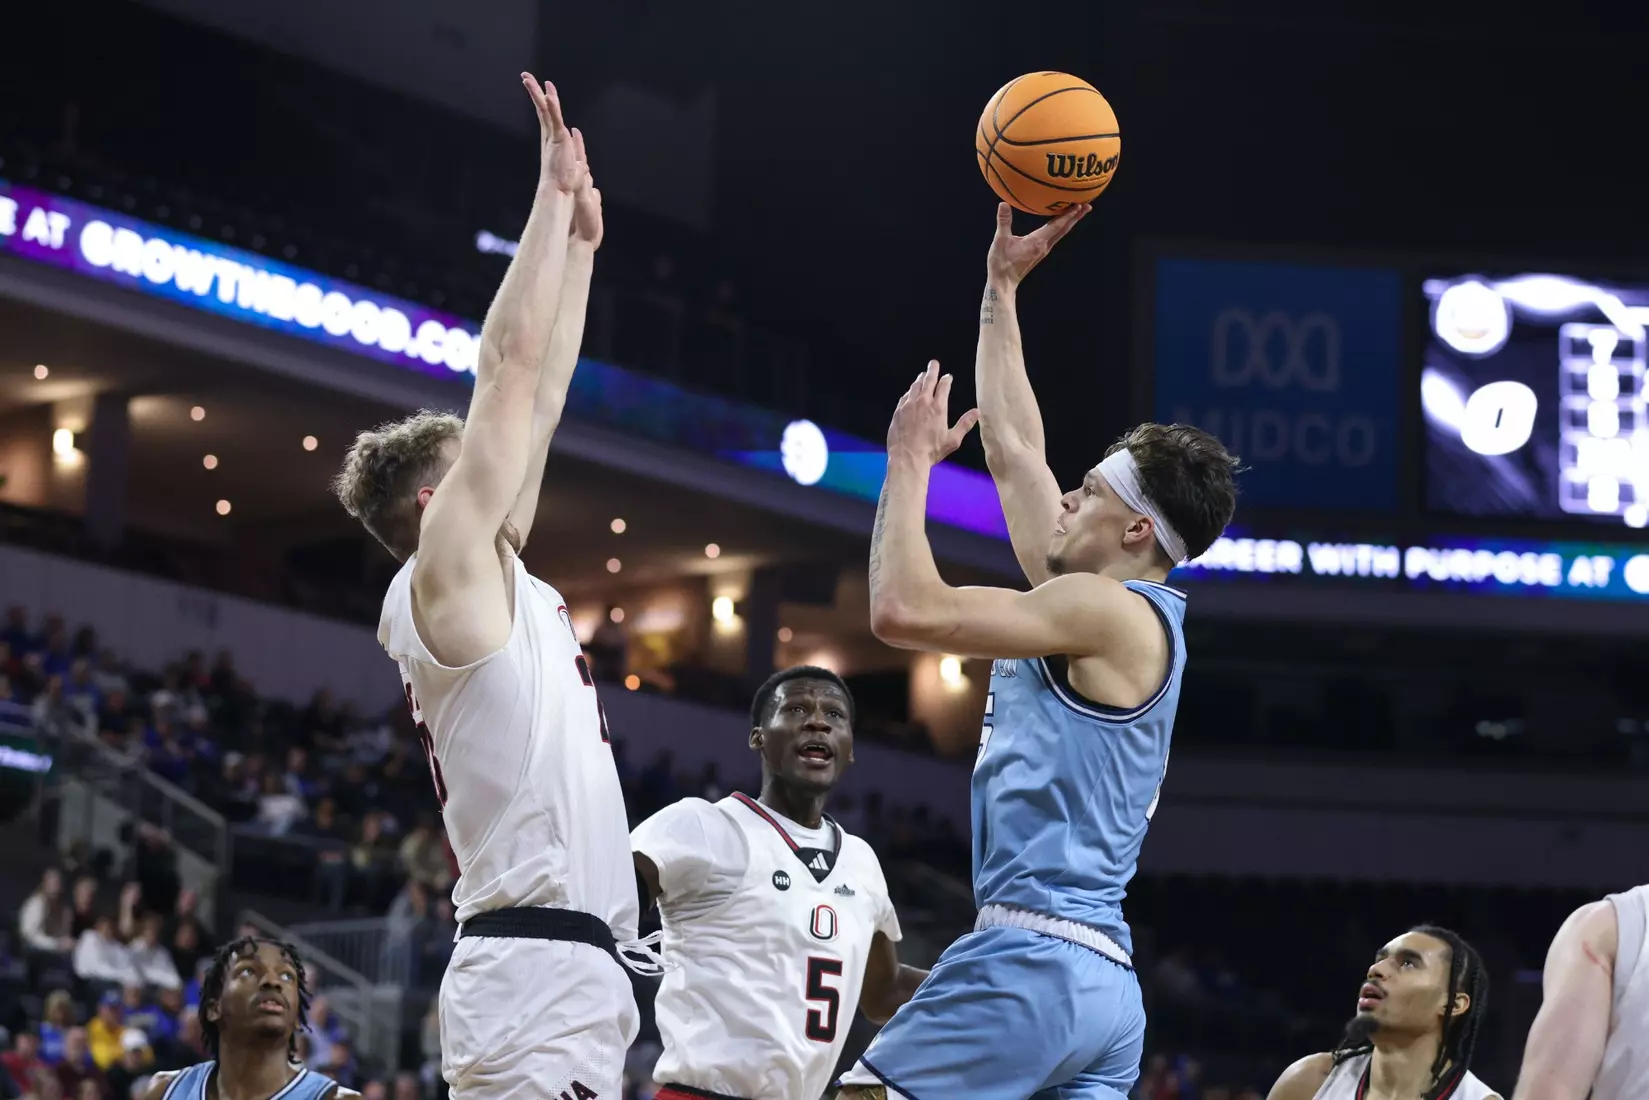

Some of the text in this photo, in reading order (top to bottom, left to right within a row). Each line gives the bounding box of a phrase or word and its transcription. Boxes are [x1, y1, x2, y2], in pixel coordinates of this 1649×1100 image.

[1046, 152, 1119, 178] Wilson
[22, 206, 71, 249] AT
[1307, 541, 1400, 578] WITH
[1404, 546, 1563, 586] PURPOSE
[1568, 555, 1616, 588] AT
[775, 875, 790, 886] HH
[805, 956, 843, 1043] 5
